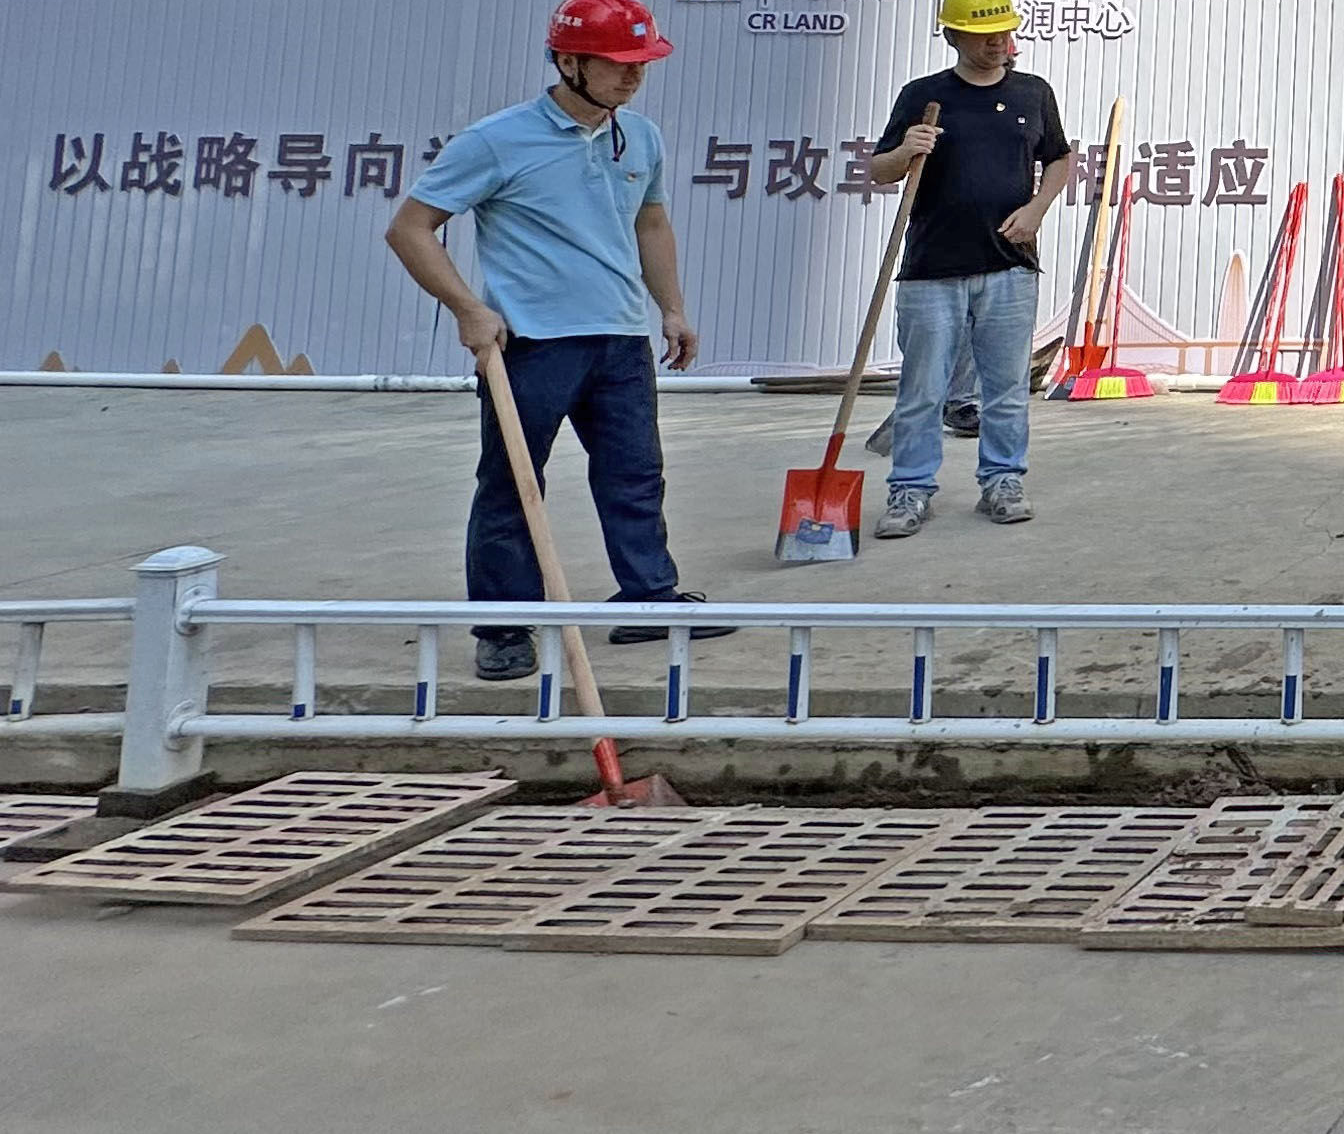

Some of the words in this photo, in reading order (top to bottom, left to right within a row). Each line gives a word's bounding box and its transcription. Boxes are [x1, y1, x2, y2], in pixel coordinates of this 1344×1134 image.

[748, 12, 775, 31] CR
[782, 12, 846, 32] LAND
[1018, 0, 1130, 35] 润中心
[48, 131, 455, 198] 以战略导向
